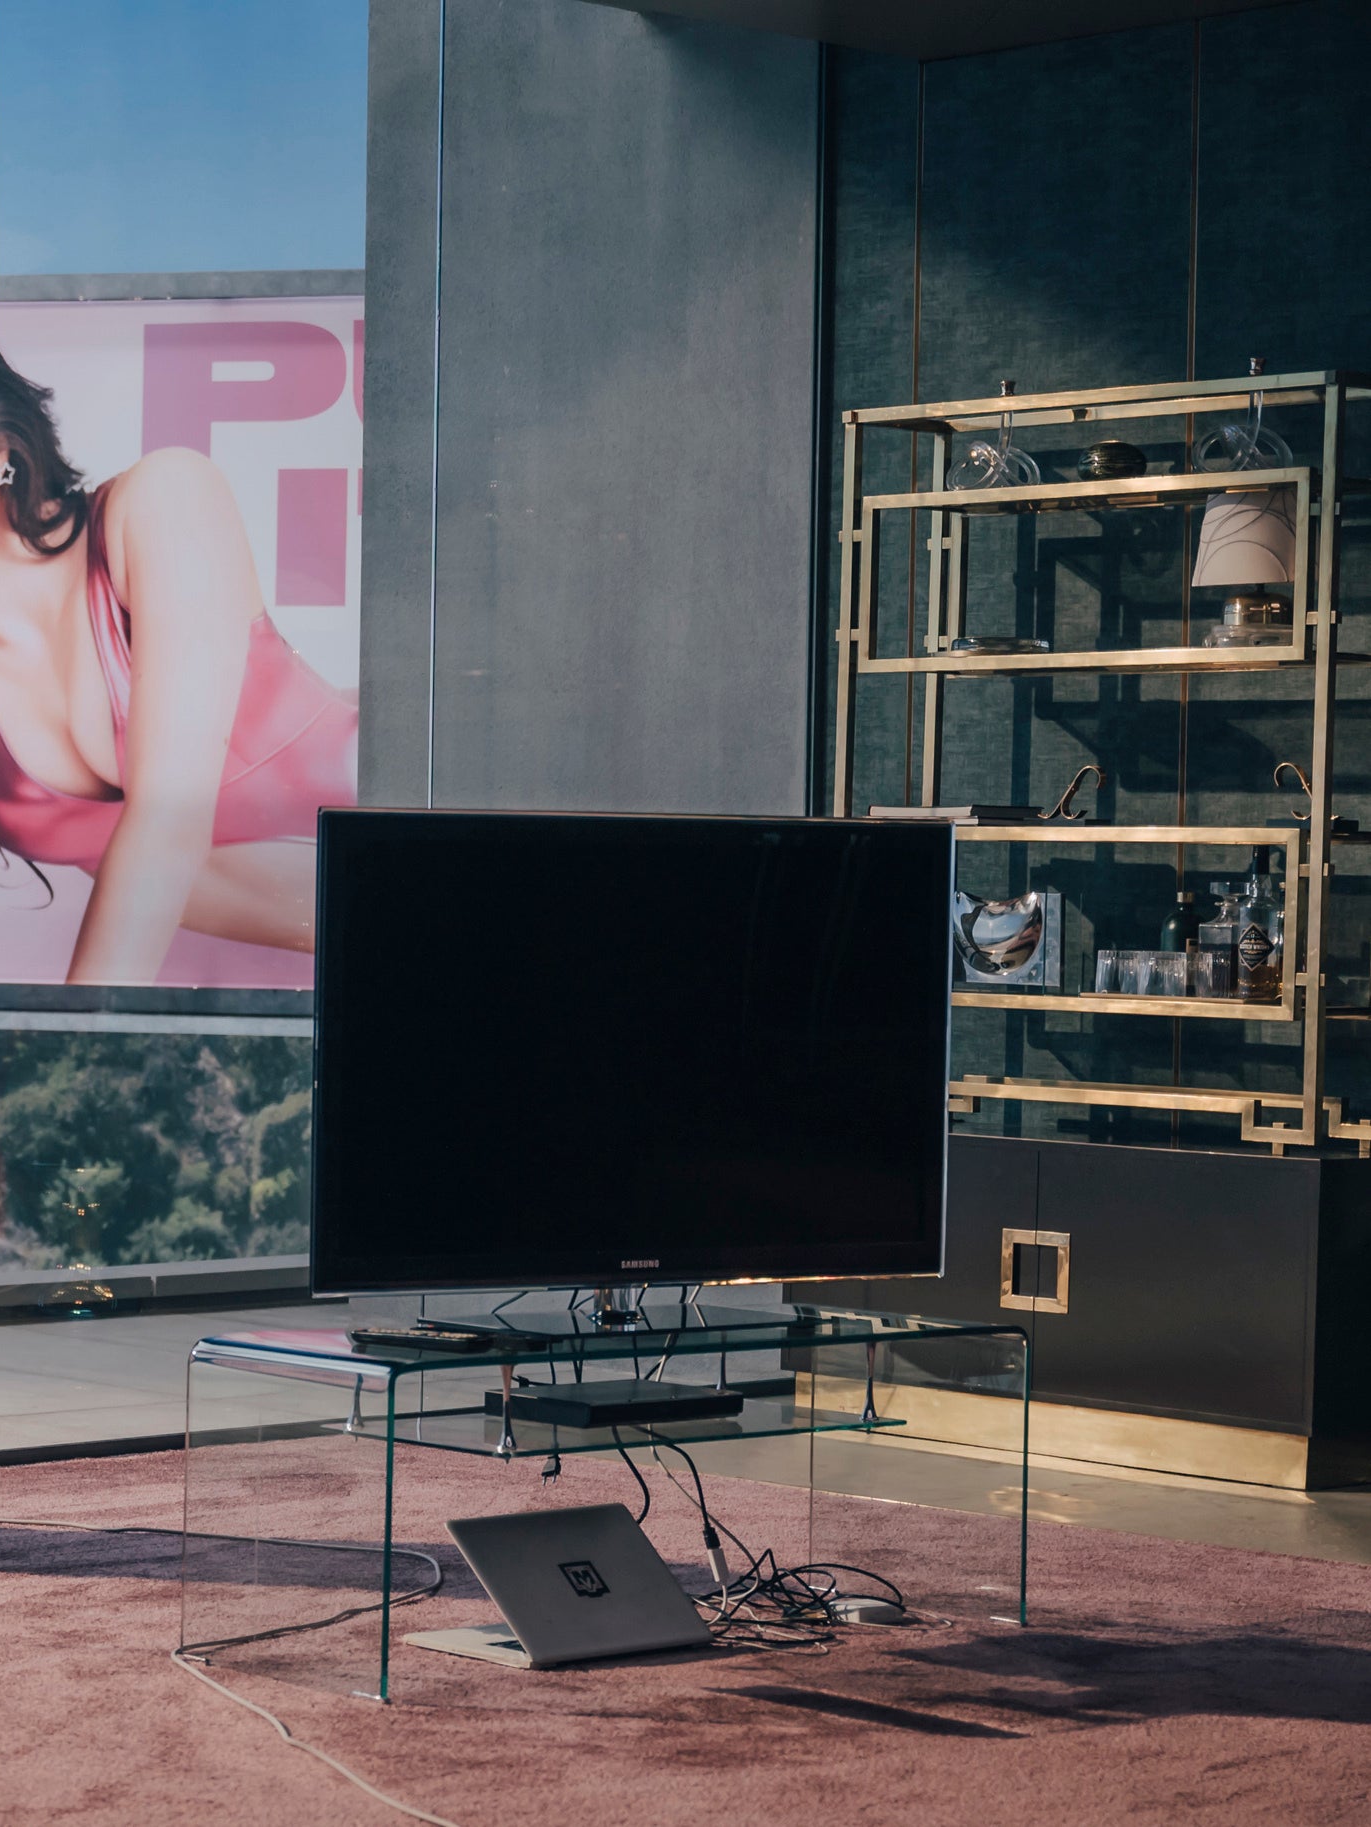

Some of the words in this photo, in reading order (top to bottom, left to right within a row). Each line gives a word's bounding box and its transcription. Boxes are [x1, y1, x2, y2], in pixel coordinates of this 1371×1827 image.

[141, 320, 365, 460] P
[275, 467, 363, 607] I
[621, 1260, 659, 1269] SAMSUNG
